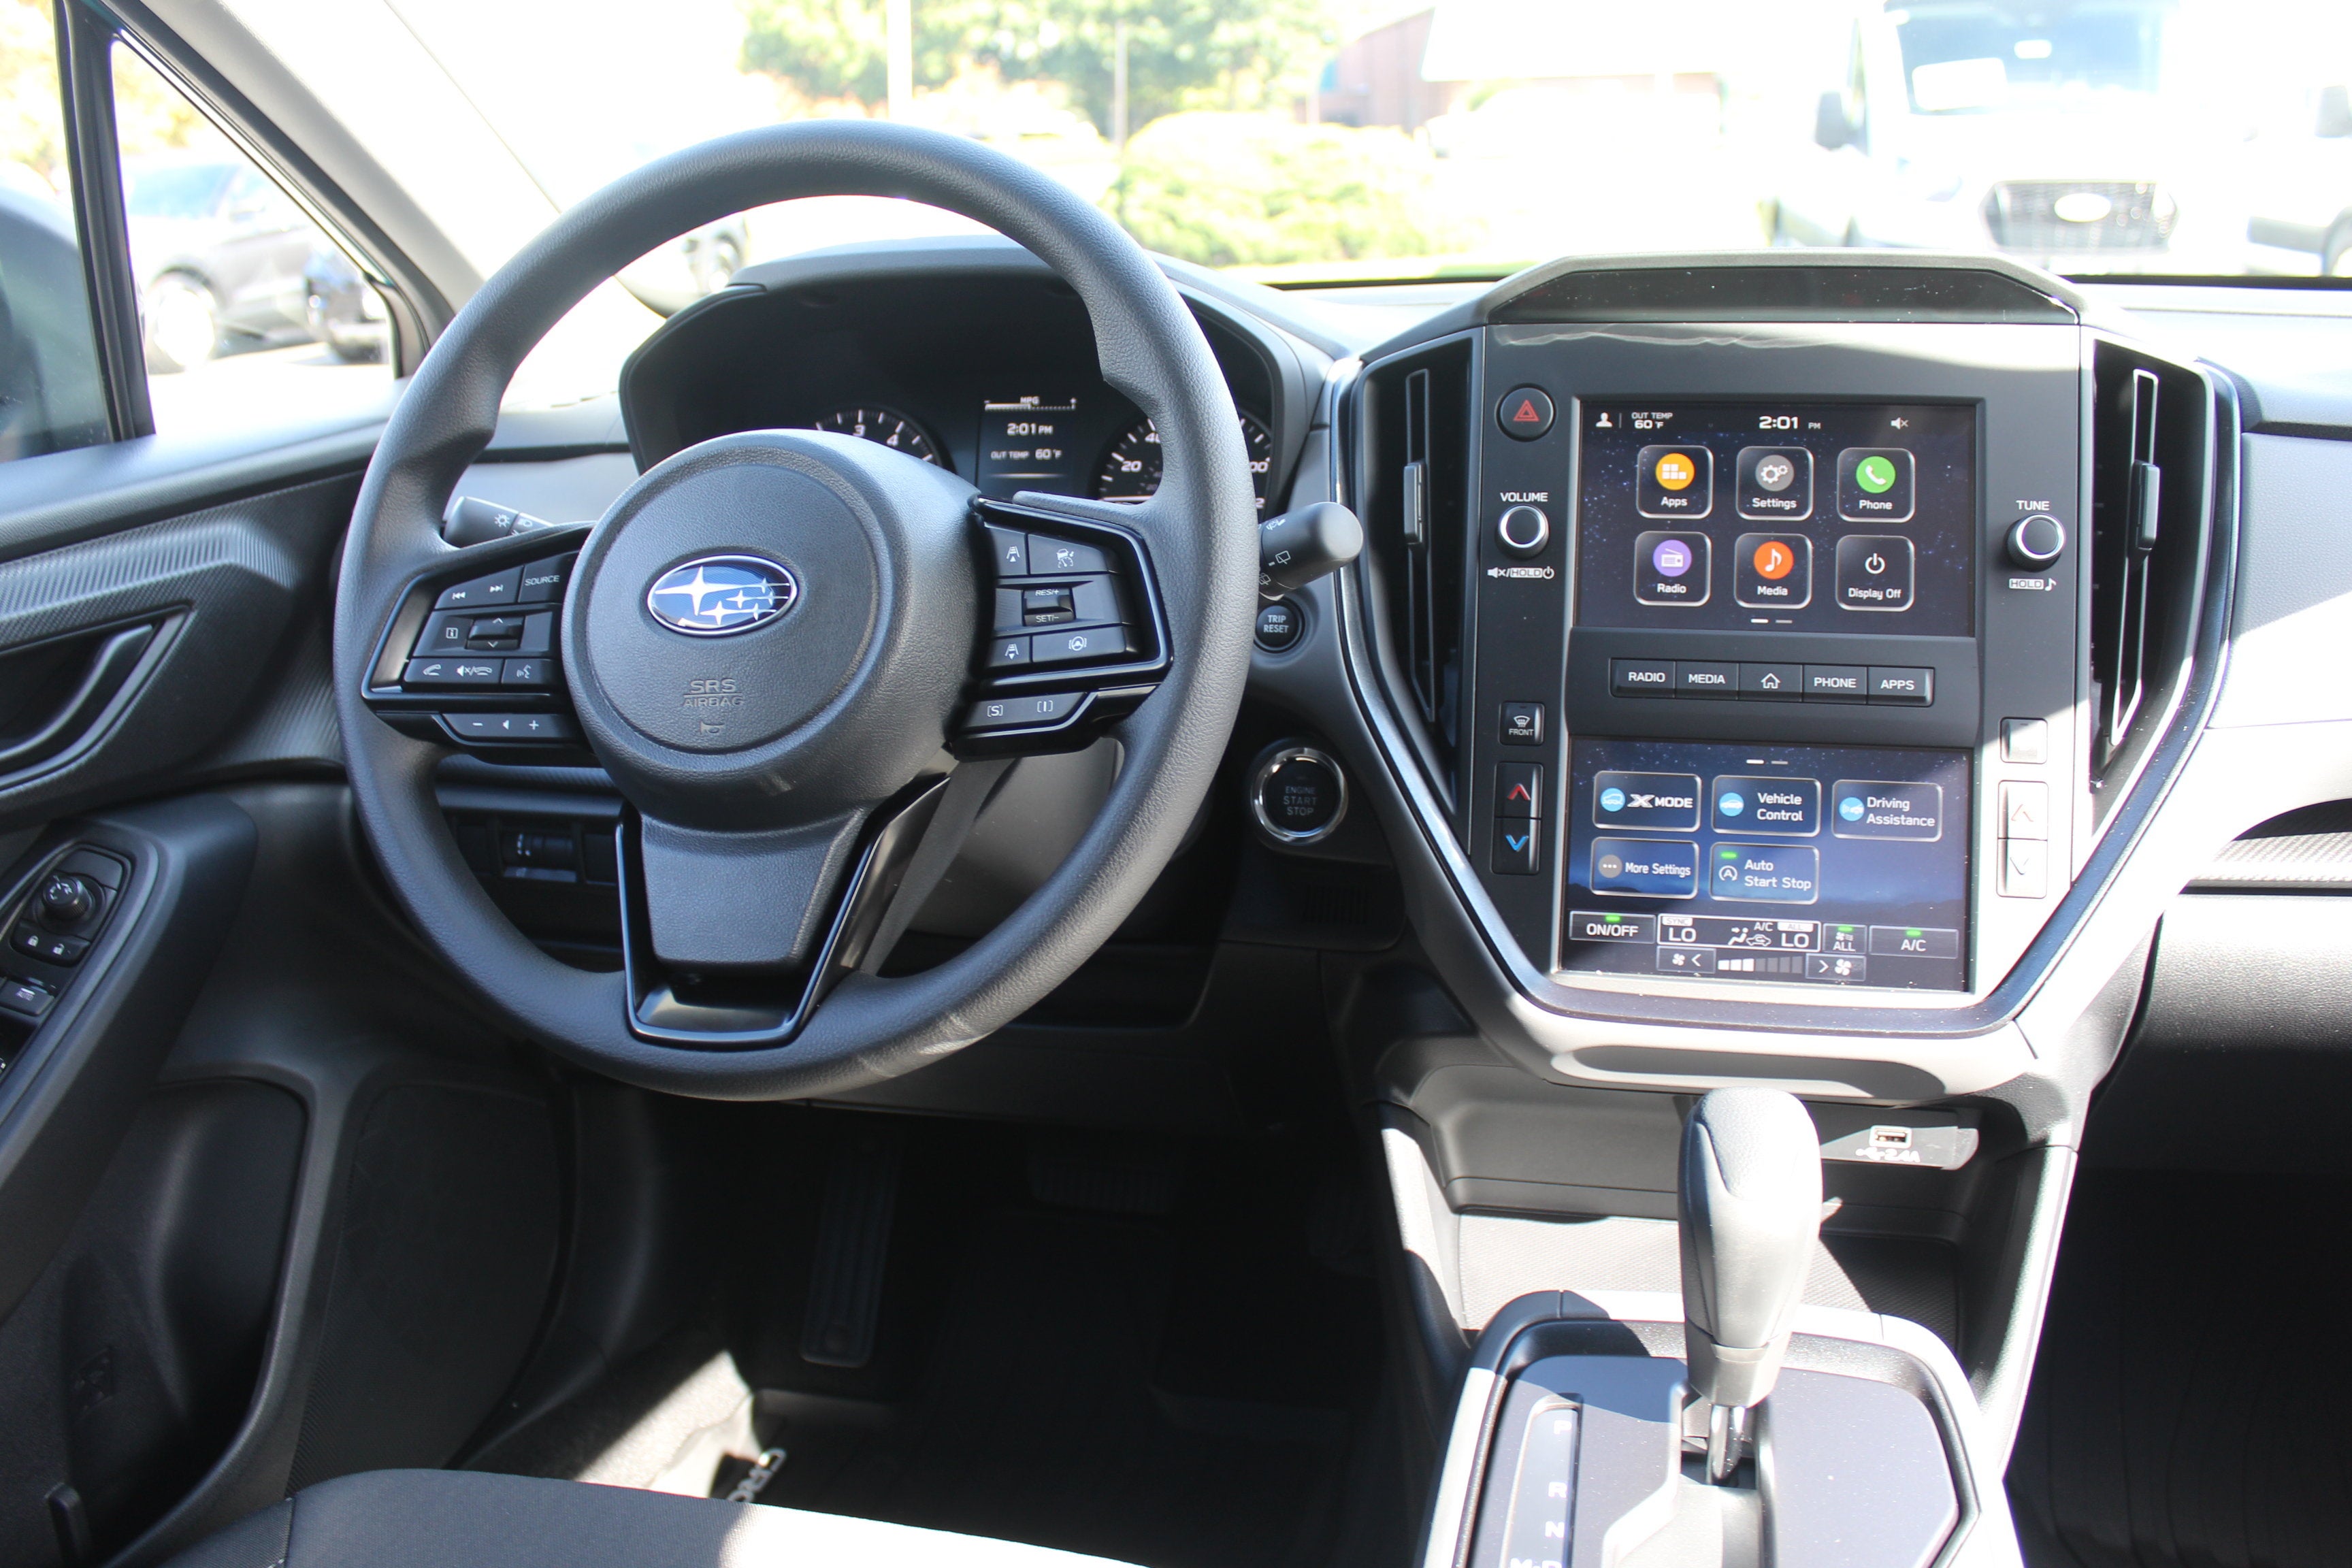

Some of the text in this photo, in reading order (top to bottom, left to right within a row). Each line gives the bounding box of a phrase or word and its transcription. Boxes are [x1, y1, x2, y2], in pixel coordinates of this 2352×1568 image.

[1020, 396, 1040, 405] MPG
[1634, 419, 1653, 429] 60
[1759, 416, 1799, 429] 2:01
[853, 424, 866, 437] 3
[1007, 423, 1053, 436] 2:01 PM
[887, 434, 898, 446] 4
[990, 451, 1006, 460] OUT
[1009, 451, 1029, 459] TEMP
[1035, 448, 1052, 460] 60
[1121, 461, 1142, 472] 20
[1500, 492, 1548, 502] VOLUME
[1661, 496, 1688, 508] Apps
[1752, 497, 1797, 510] Settings
[1859, 500, 1893, 510] Phone
[2016, 500, 2051, 511] TUNE
[1511, 568, 1543, 577] HOLD
[524, 574, 560, 586] SOURCE
[2010, 579, 2043, 589] HOLD
[1656, 583, 1686, 594] Radio
[1757, 585, 1788, 596] Media
[1848, 587, 1901, 601] Display Off
[1267, 615, 1286, 623] TRIP
[1263, 624, 1289, 634] RESET
[1628, 671, 1666, 683] RADIO
[1688, 673, 1726, 685] MEDIA
[1814, 676, 1857, 689] PHONE
[690, 678, 736, 693] SRS
[1880, 679, 1915, 691] APPS
[683, 696, 745, 708] AIRBAG
[1285, 786, 1316, 795] ENGINE
[1284, 796, 1318, 805] START
[1654, 796, 1694, 808] MODE
[1757, 793, 1802, 806] Vehicle
[1867, 797, 1910, 813] Driving
[1286, 806, 1314, 816] STOP
[1757, 808, 1803, 822] Control
[1866, 815, 1936, 828] Assistance
[1625, 862, 1691, 878] More Settings
[1744, 860, 1774, 872] Auto
[1744, 877, 1812, 892] Start Stop
[1667, 917, 1688, 926] SYNC
[1753, 921, 1774, 932] A/C
[1586, 924, 1638, 938] ON/OFF
[1669, 927, 1697, 943] LO
[1781, 933, 1810, 948] LO
[1833, 941, 1856, 952] ALL
[1900, 938, 1926, 952] A/C
[1553, 1420, 1572, 1435] P
[1548, 1482, 1567, 1498] R
[1544, 1521, 1565, 1538] N
